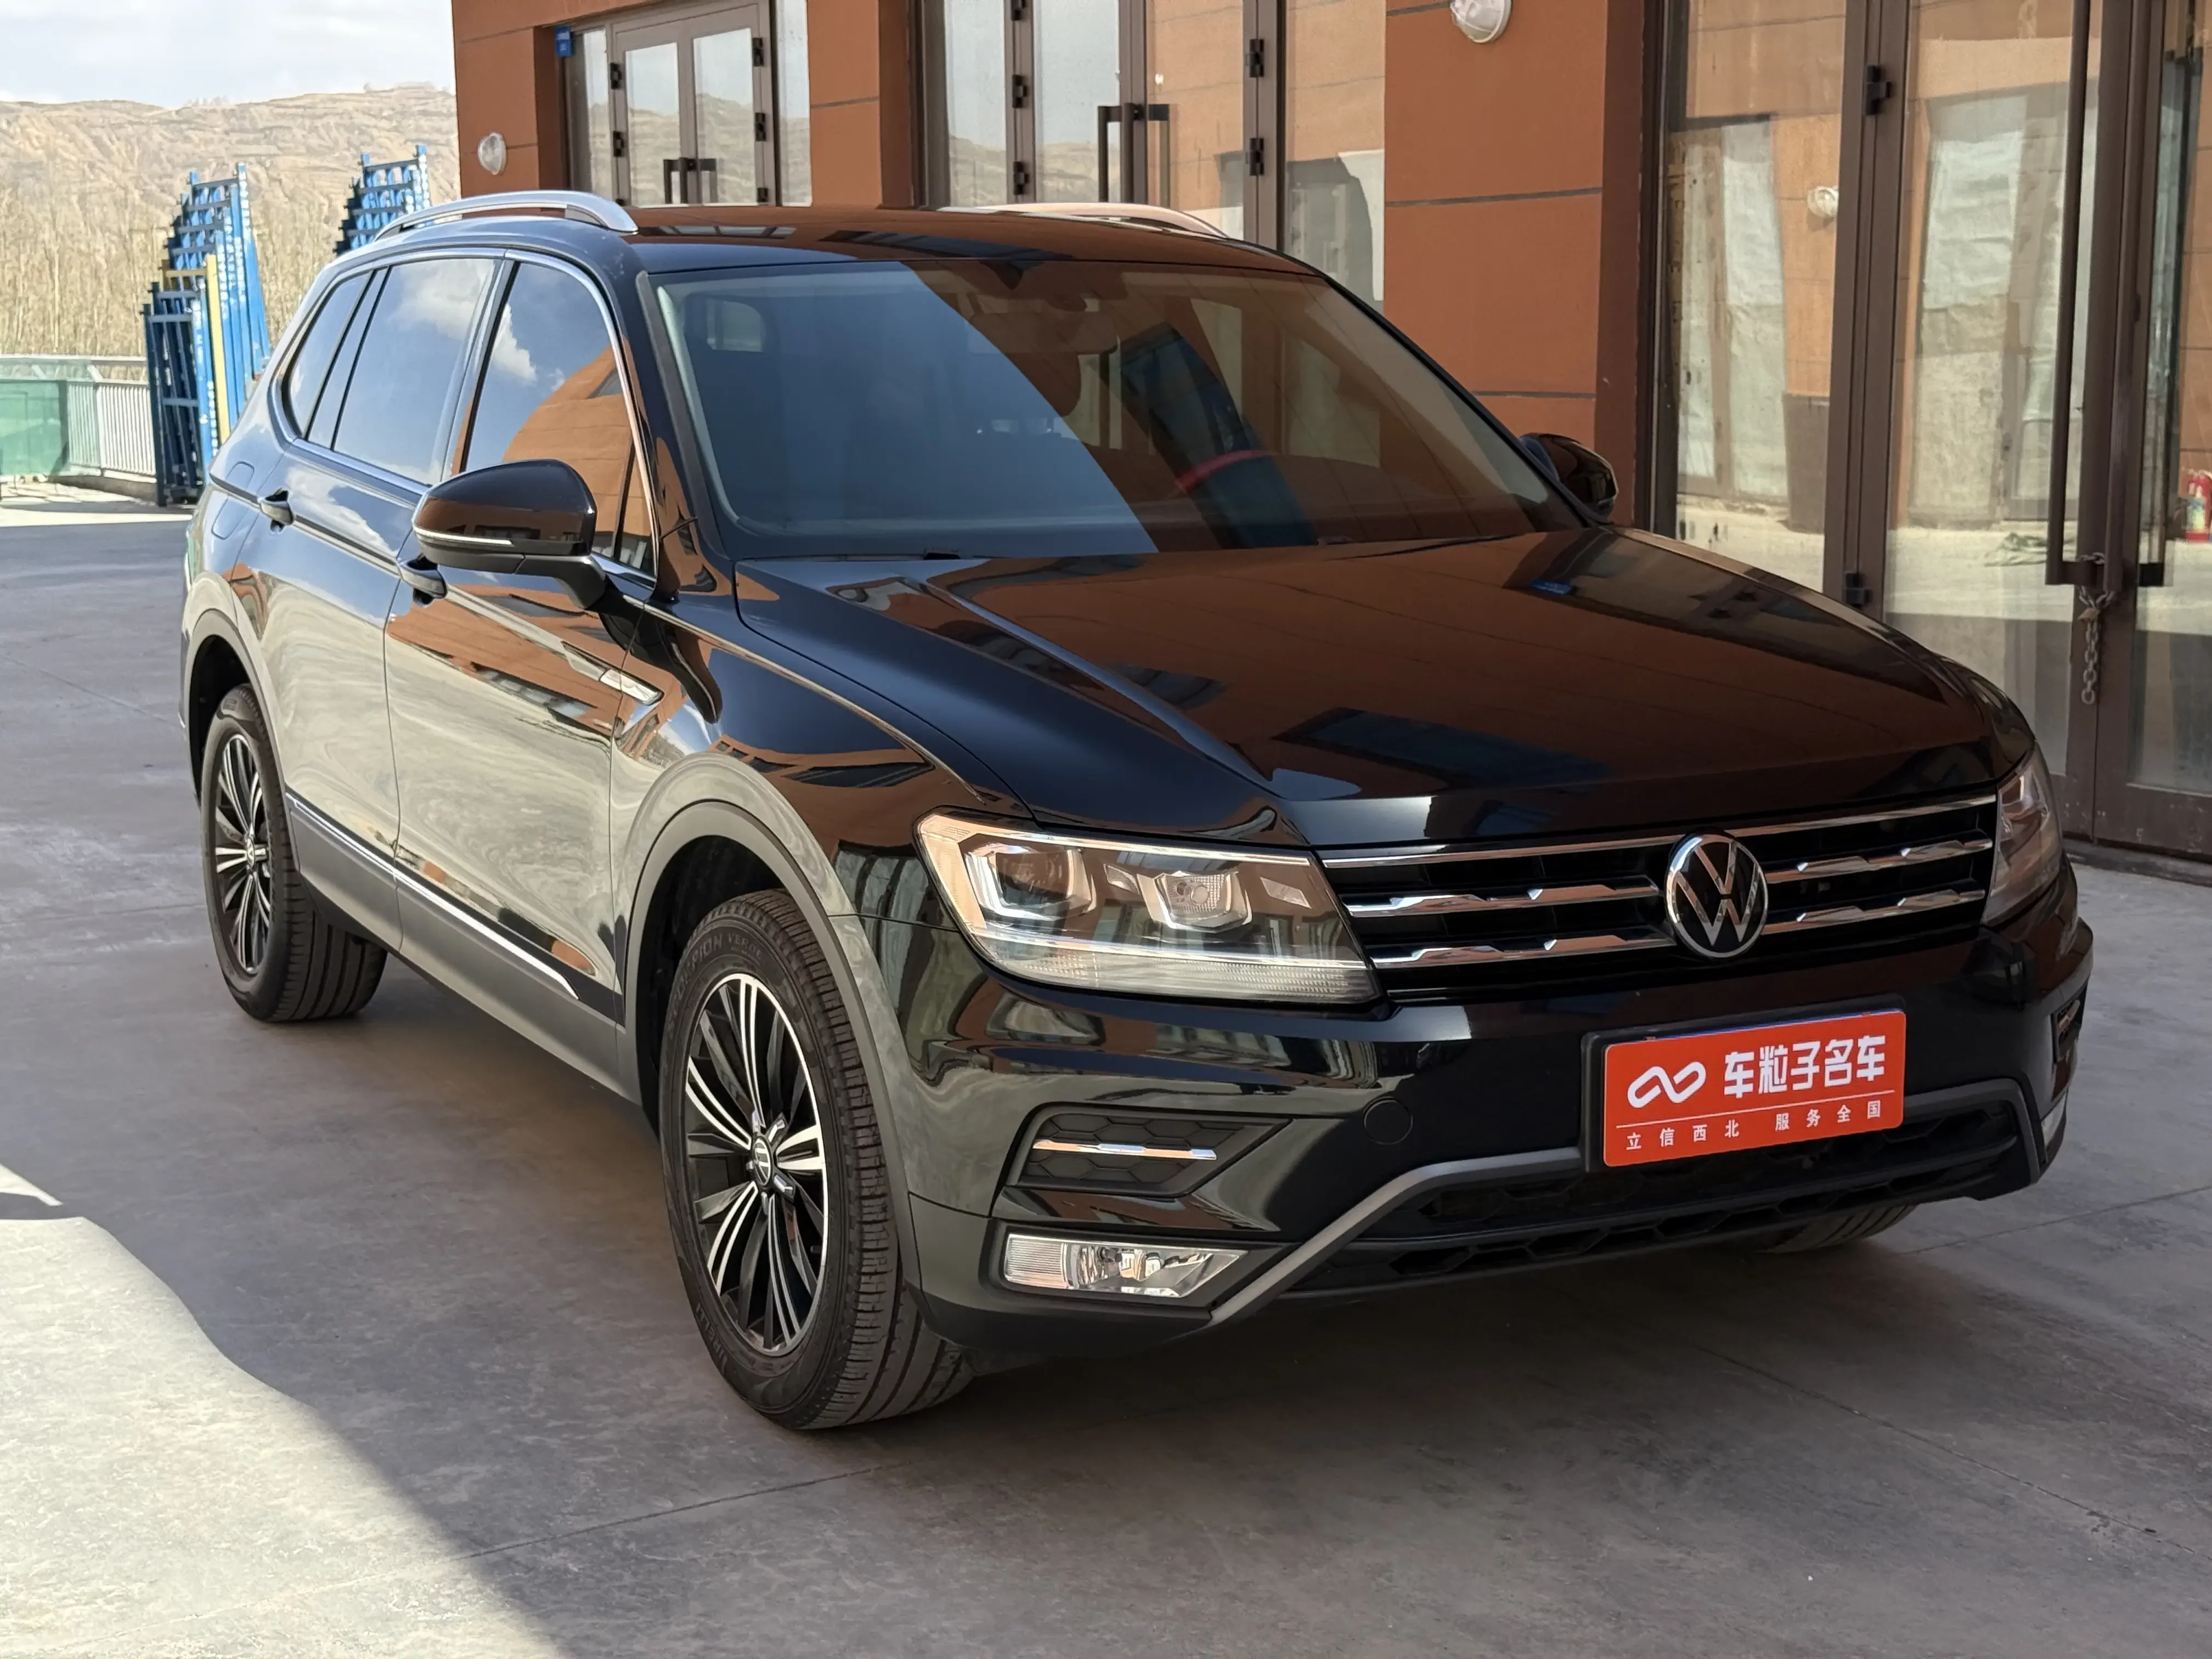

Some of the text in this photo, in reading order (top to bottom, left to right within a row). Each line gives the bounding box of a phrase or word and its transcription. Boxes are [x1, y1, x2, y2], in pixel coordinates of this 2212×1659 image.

[1724, 1035, 1886, 1099] 车粒子名车
[1626, 1099, 1881, 1150] 立信西北 服务全国
[695, 1302, 727, 1375] PIRELLI
